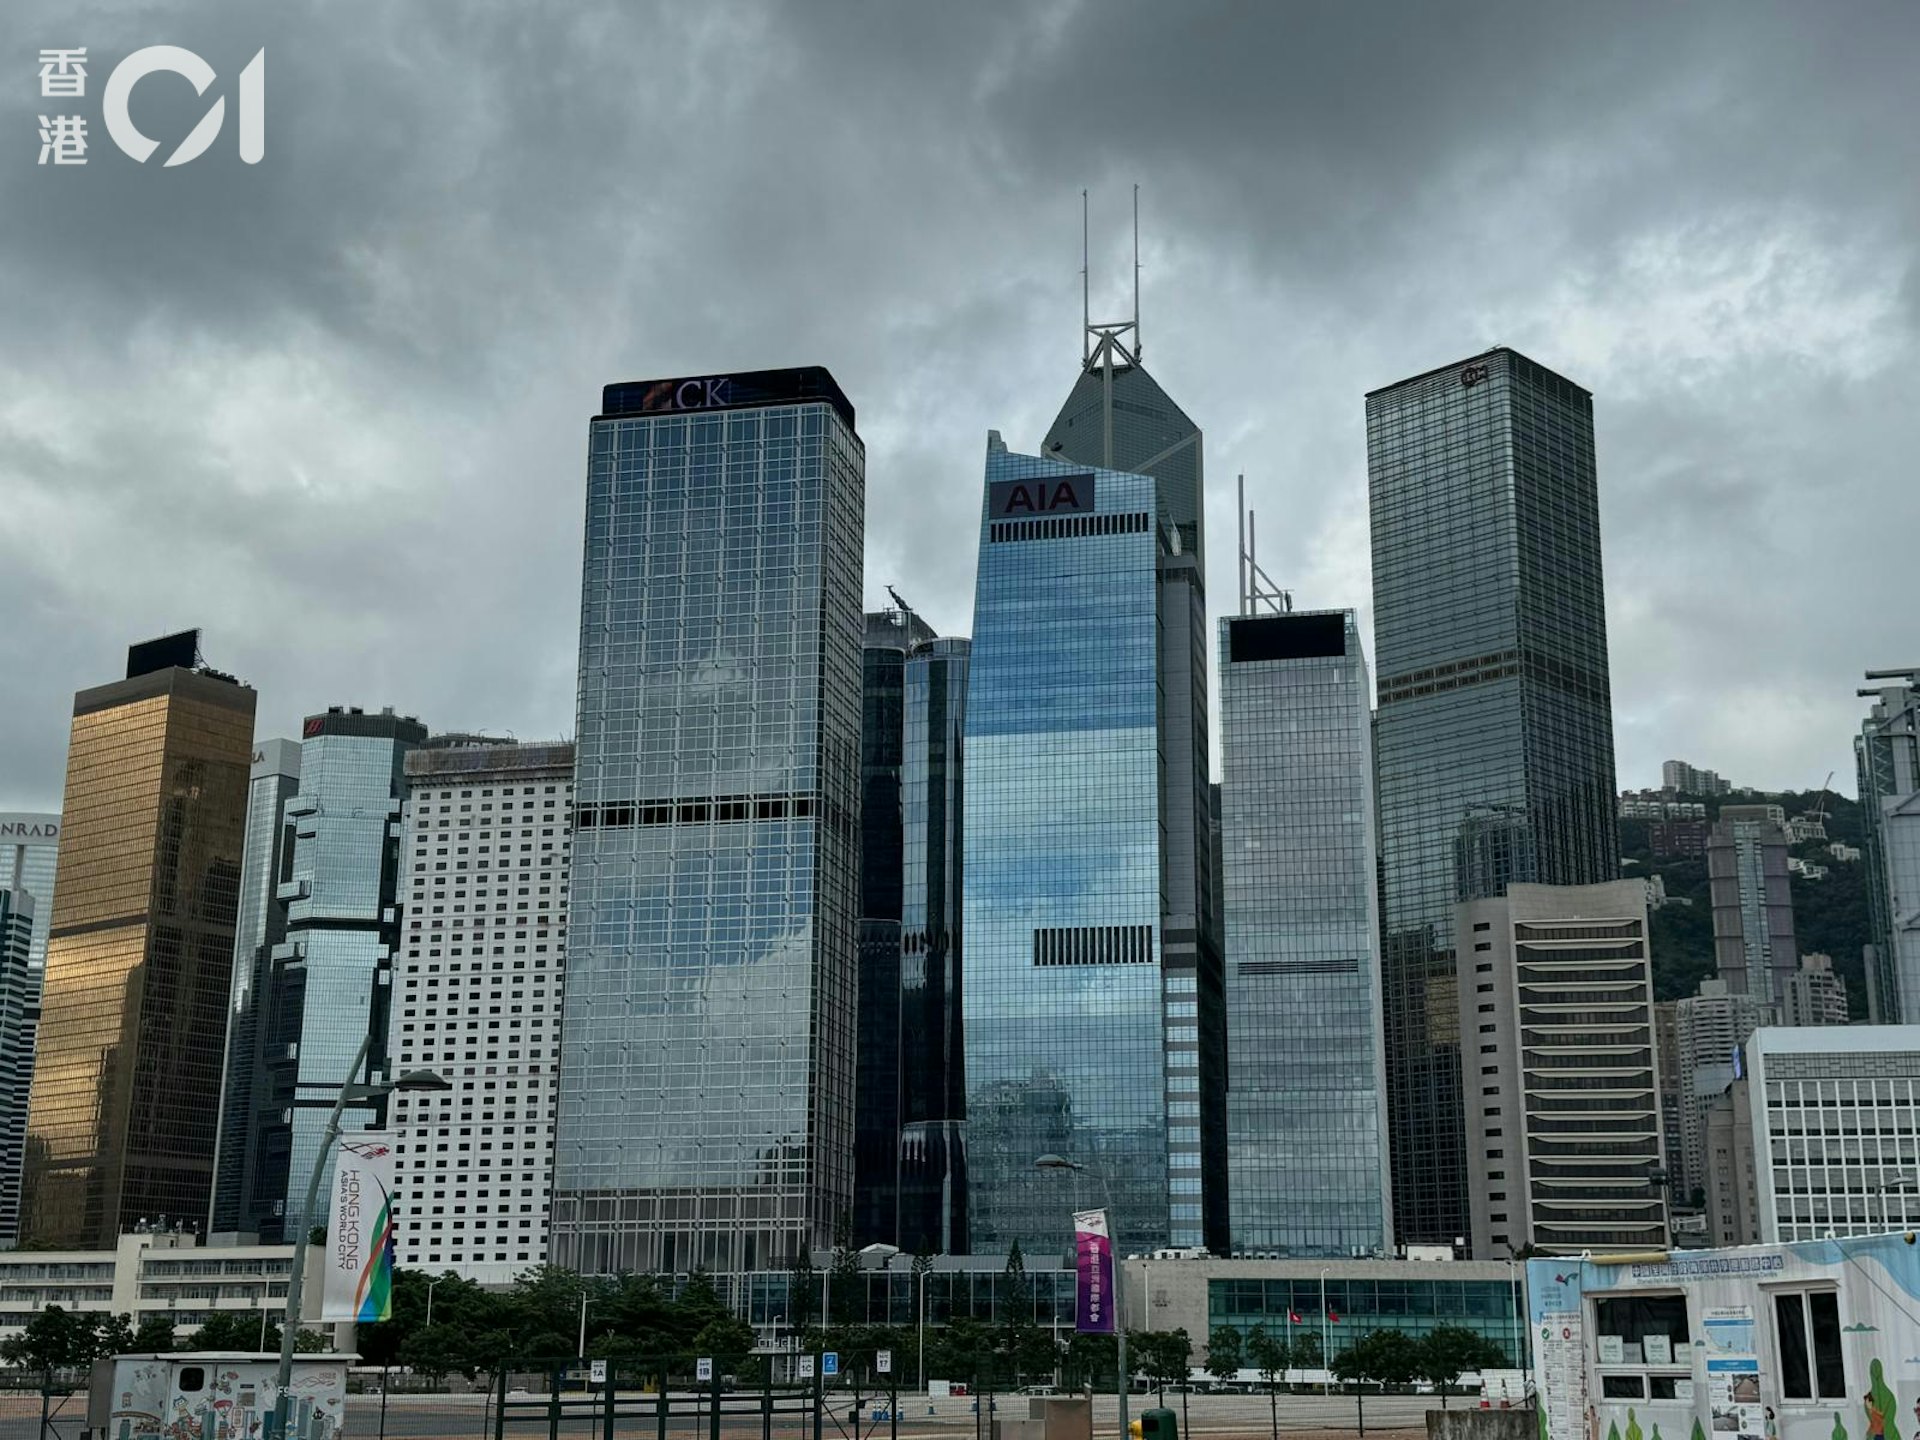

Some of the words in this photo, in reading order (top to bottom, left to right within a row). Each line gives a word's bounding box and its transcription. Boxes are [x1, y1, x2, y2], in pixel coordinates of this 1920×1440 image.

[676, 378, 729, 409] CK
[1005, 481, 1080, 513] AIA
[340, 1170, 348, 1203] ASIA'S
[348, 1170, 360, 1217] HONG
[339, 1204, 348, 1241] WORLD
[337, 1242, 347, 1271] CITY
[347, 1221, 359, 1271] KONG
